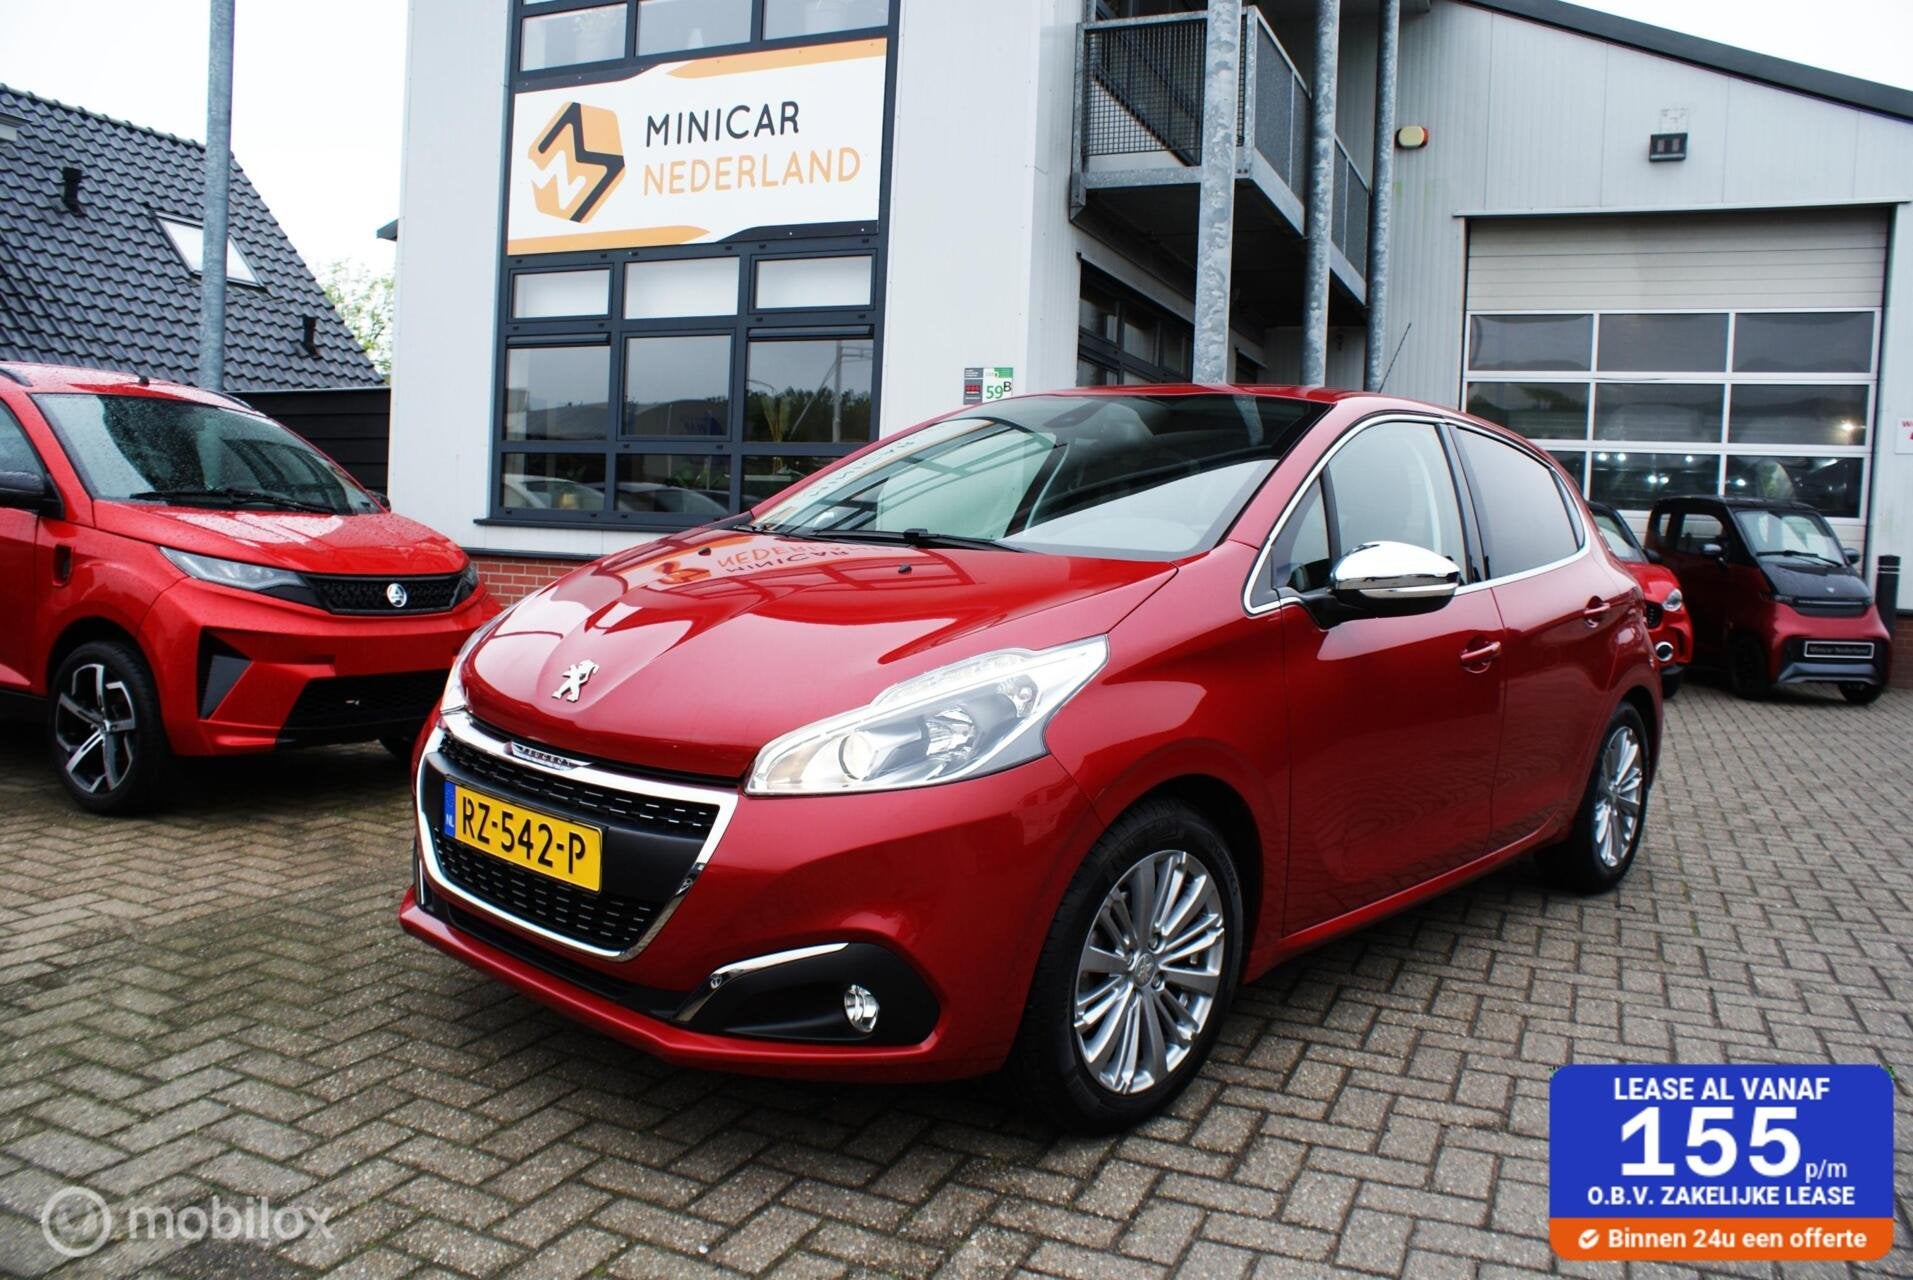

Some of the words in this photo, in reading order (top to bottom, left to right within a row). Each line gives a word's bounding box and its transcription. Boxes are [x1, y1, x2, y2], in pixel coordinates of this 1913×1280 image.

[646, 100, 799, 148] MINICAR
[643, 146, 861, 196] NEDERLAND
[462, 796, 586, 874] RZ-542-P
